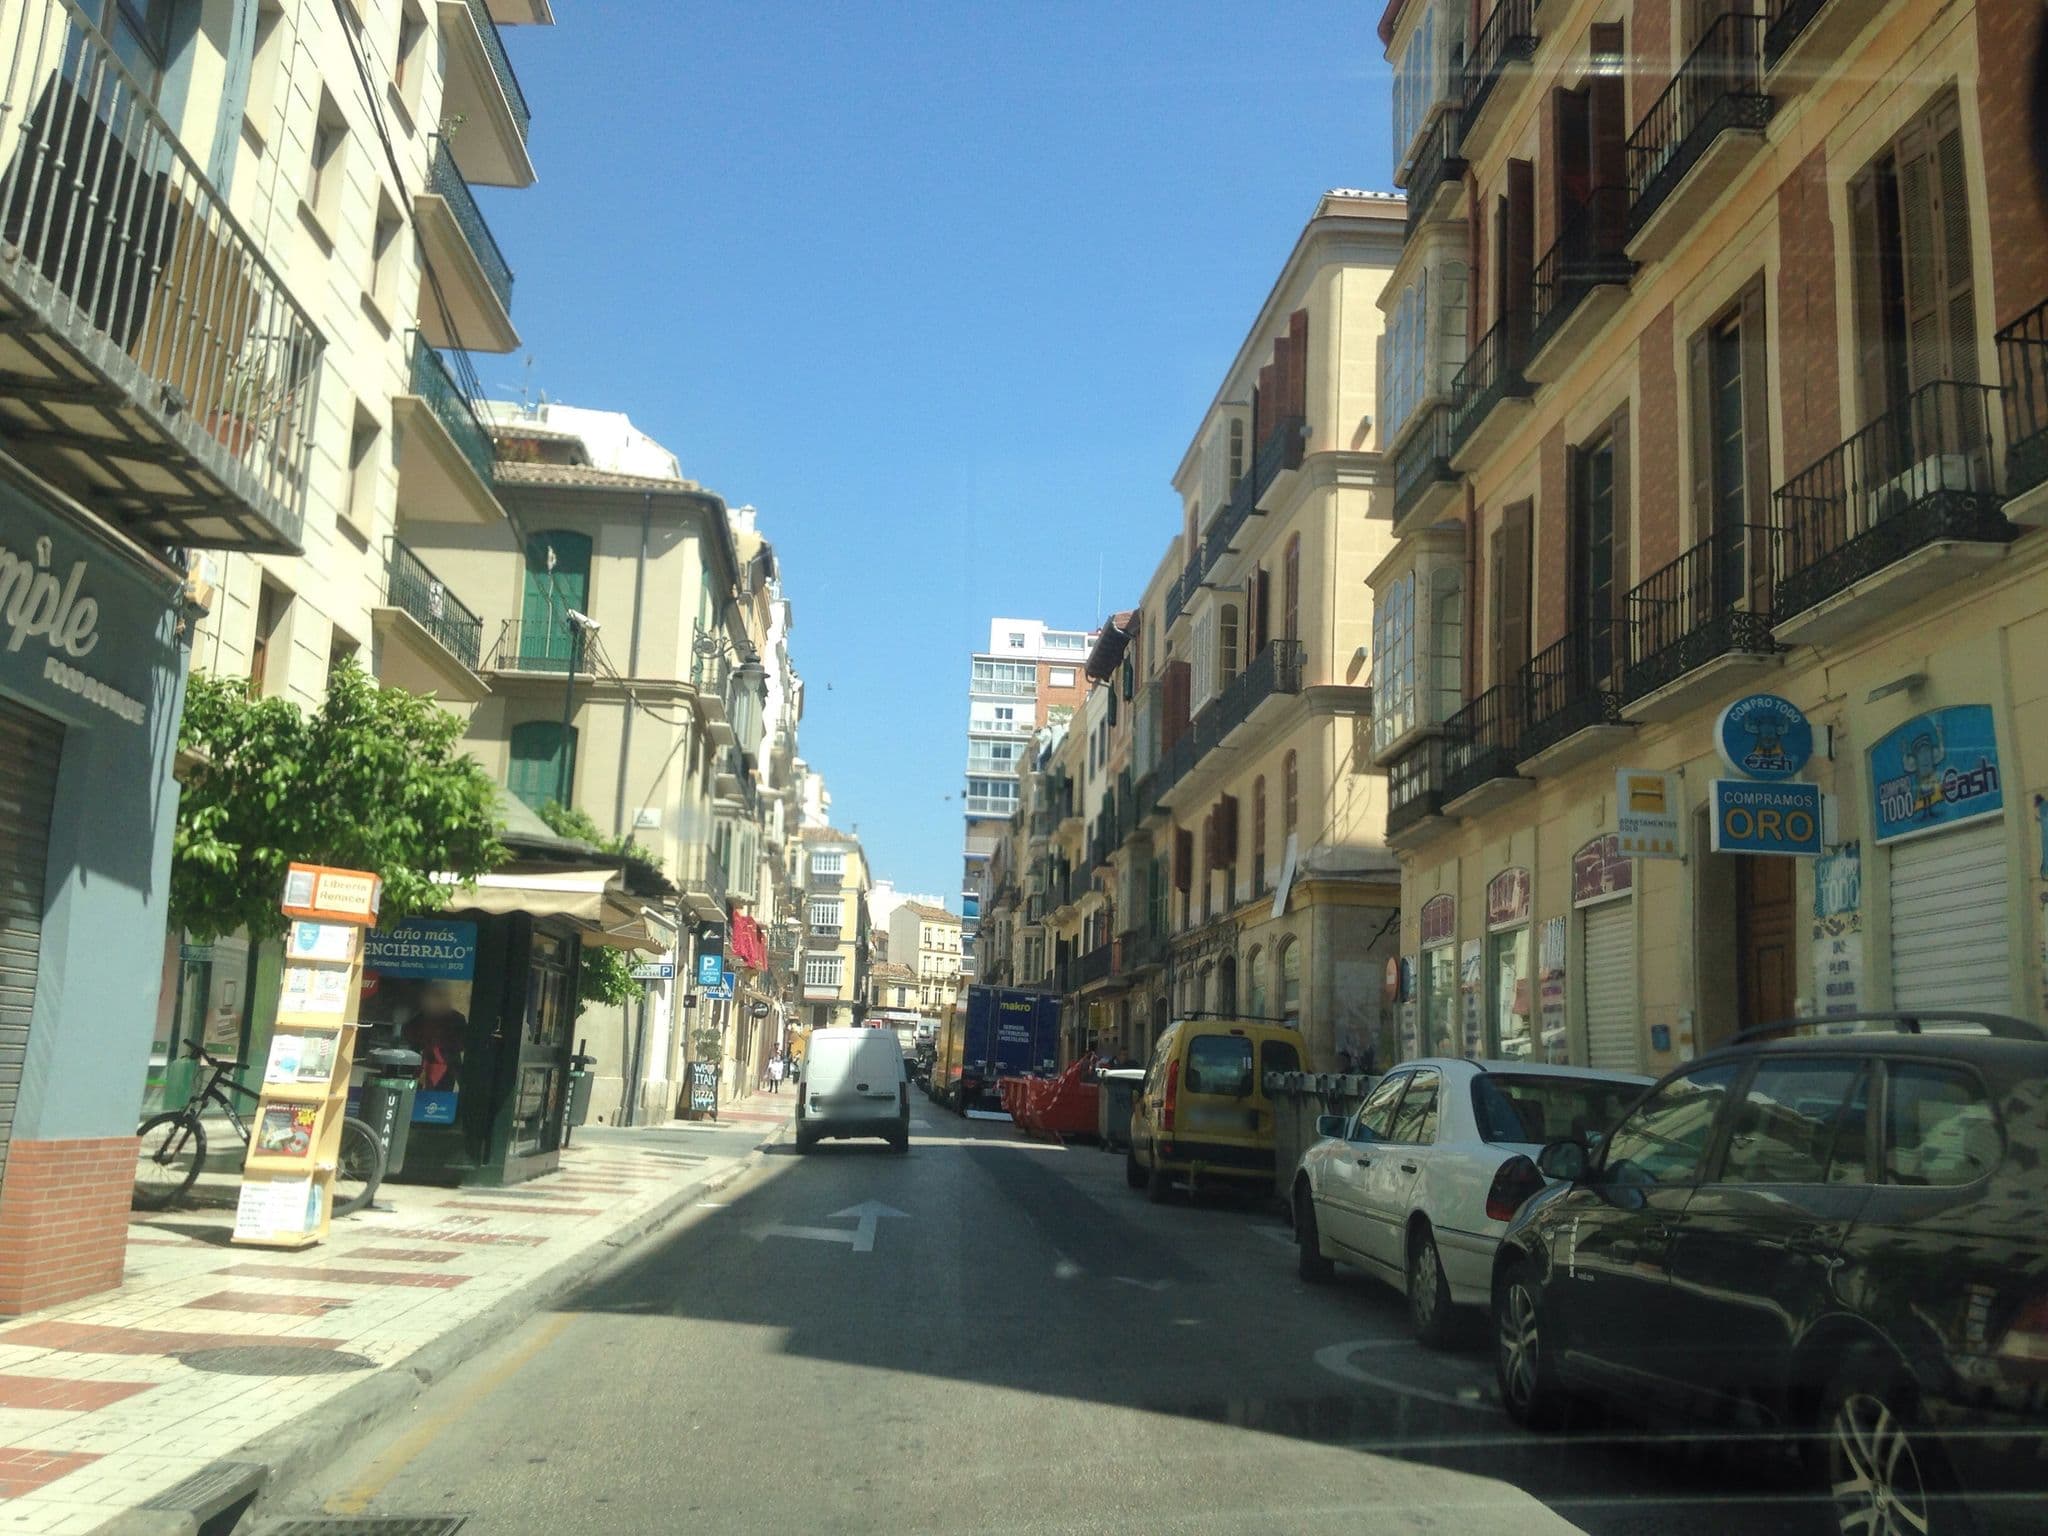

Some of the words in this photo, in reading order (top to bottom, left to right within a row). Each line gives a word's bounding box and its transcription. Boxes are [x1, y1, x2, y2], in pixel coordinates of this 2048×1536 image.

[1730, 698, 1773, 721] COMPRO
[1775, 700, 1801, 723] TODO
[1724, 791, 1813, 808] COMPRAMOS
[1880, 791, 1914, 823] TODO
[1725, 807, 1814, 842] ORO
[393, 927, 421, 940] año
[1000, 1001, 1031, 1012] makro
[694, 1072, 717, 1086] ITALY
